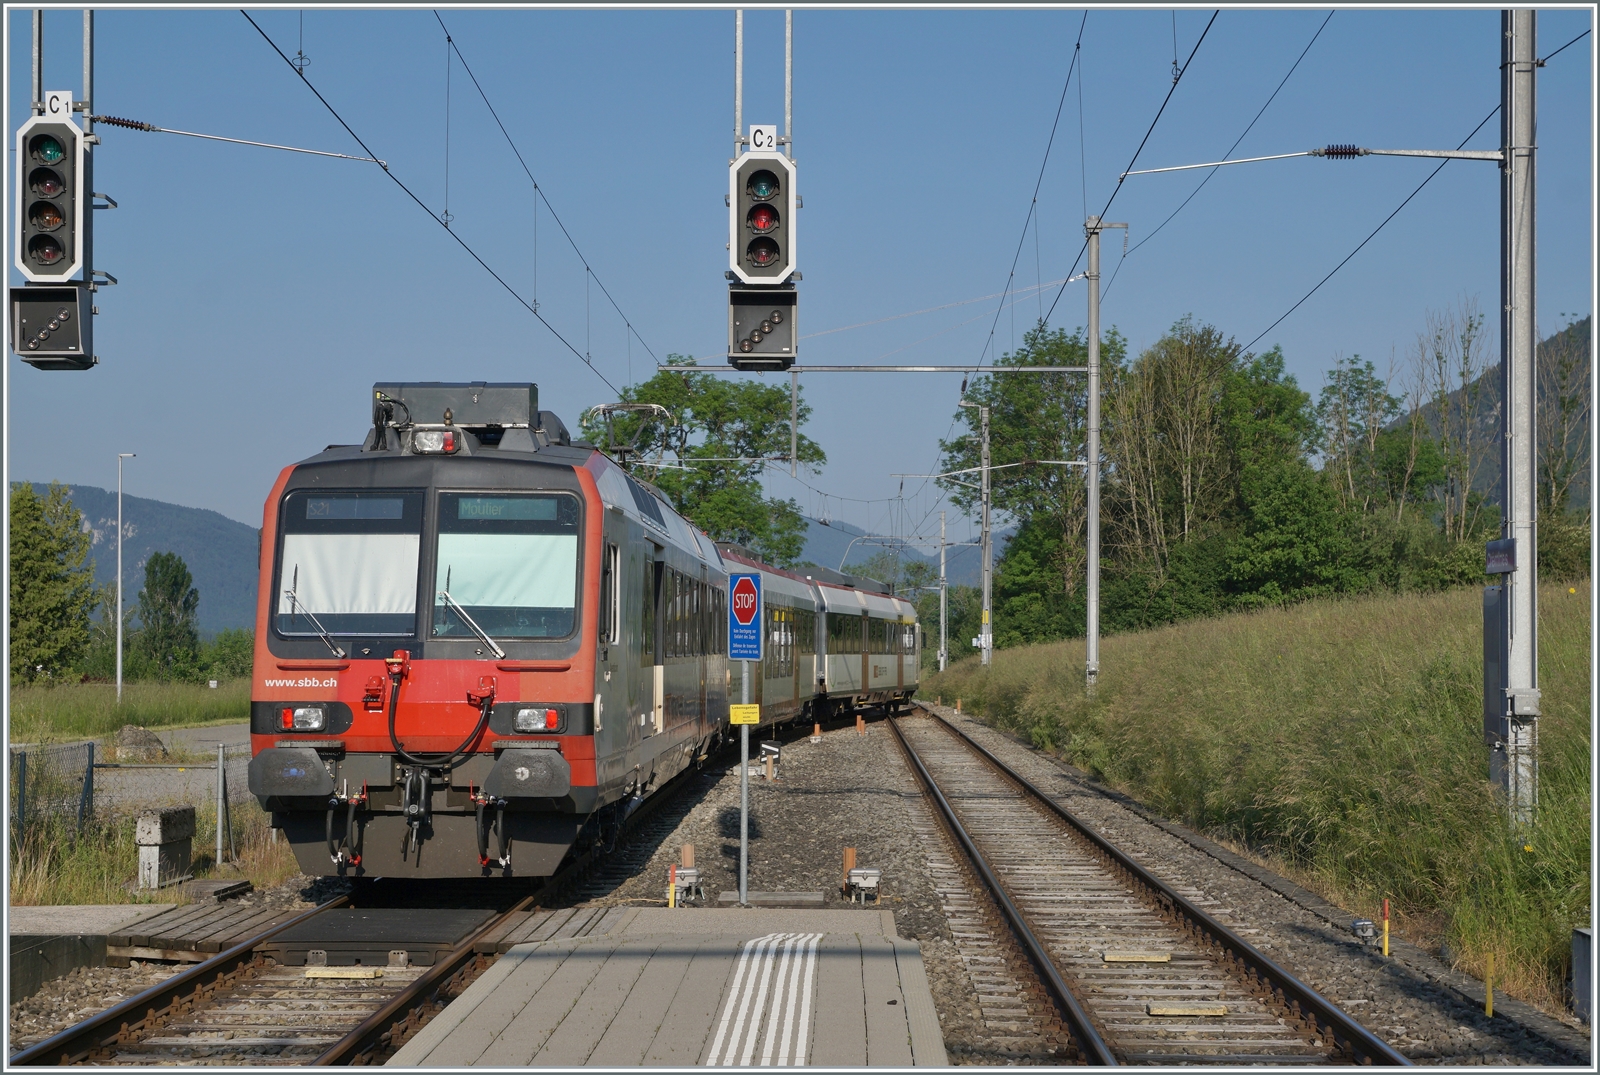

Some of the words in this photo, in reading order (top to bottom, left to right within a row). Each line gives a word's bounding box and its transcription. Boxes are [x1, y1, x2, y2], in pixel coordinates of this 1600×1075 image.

[49, 95, 59, 114] C
[64, 101, 69, 113] 1
[753, 129, 764, 148] C
[767, 135, 773, 148] 2
[309, 502, 330, 516] S21
[461, 502, 504, 516] Moutier
[736, 593, 754, 608] STOP
[265, 678, 337, 687] www.sbb.ch
